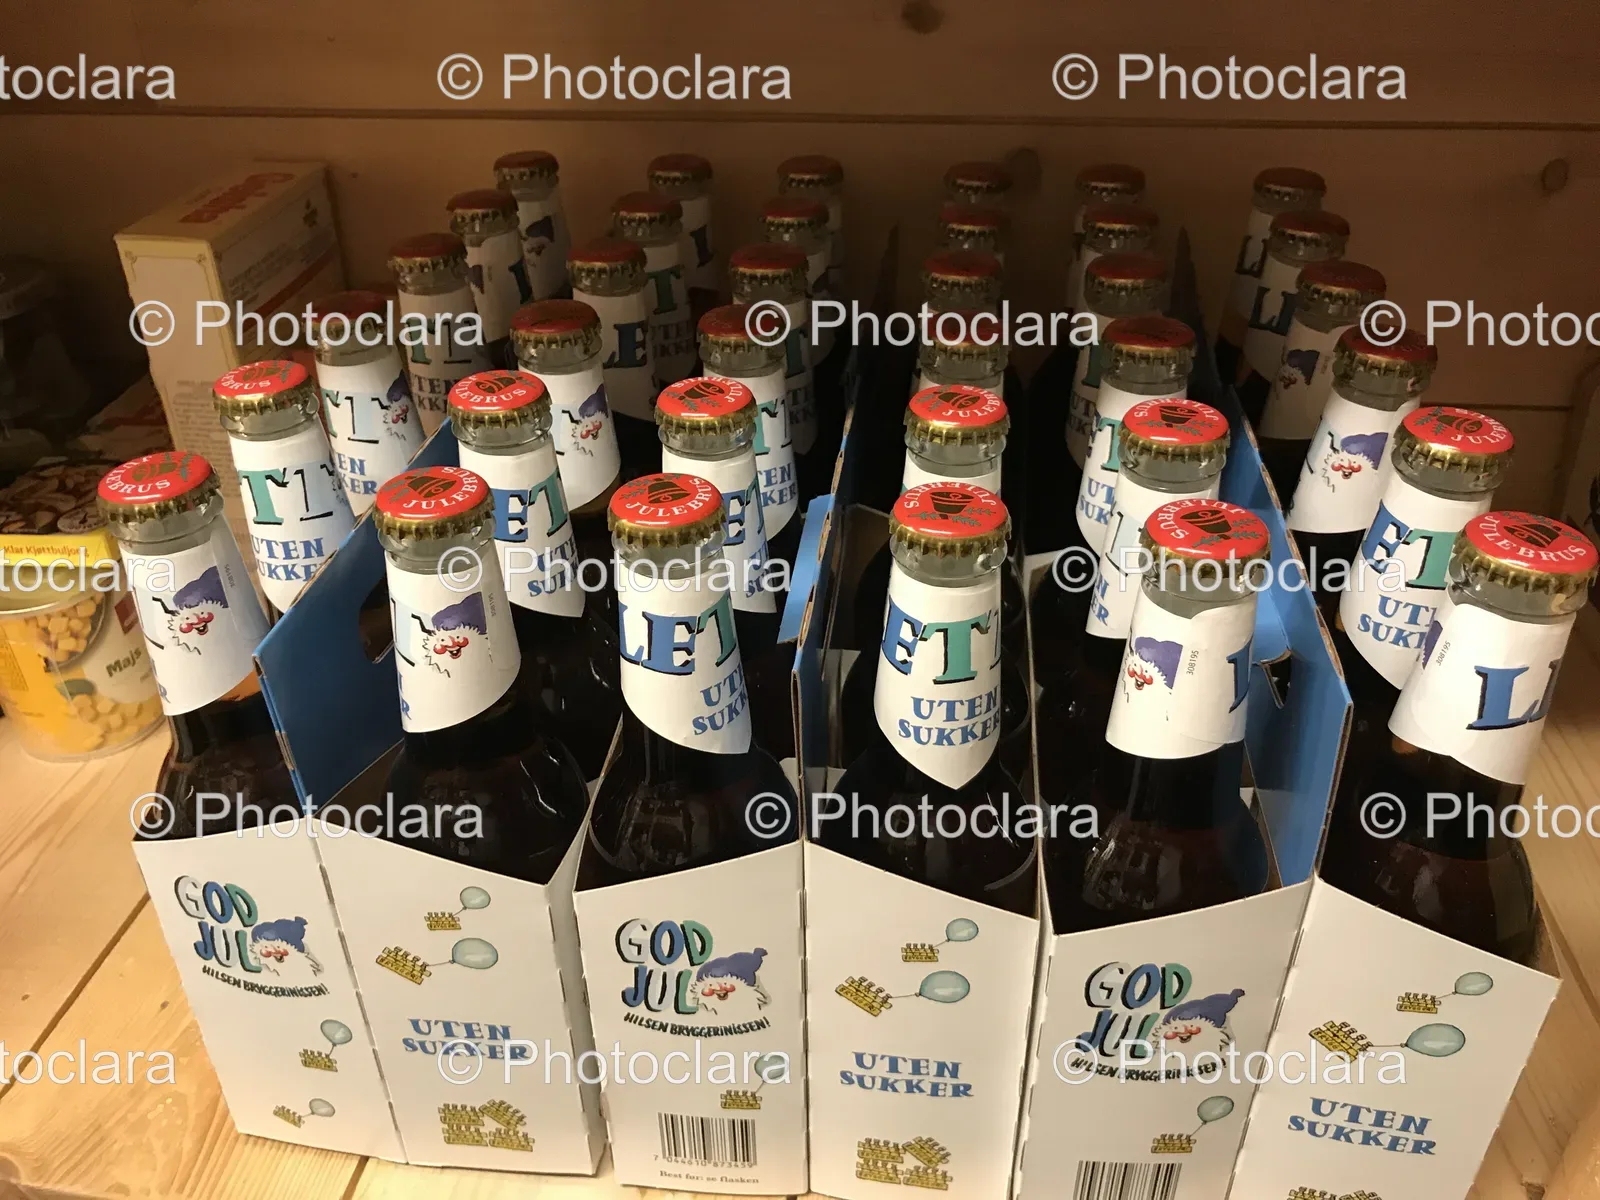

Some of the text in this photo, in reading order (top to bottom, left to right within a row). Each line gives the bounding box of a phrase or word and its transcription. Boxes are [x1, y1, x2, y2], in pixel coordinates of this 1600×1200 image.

[455, 375, 527, 404] JULEBRUS
[403, 466, 479, 510] JULEBRUS
[626, 477, 713, 518] JULEBRUS
[903, 481, 997, 510] JULEBRUS
[1157, 499, 1246, 540] JULEBRUS
[1478, 514, 1587, 563] JULEBRUS
[106, 647, 142, 678] Majs
[1186, 649, 1200, 676] 308195
[1435, 640, 1451, 667] 308195
[174, 875, 259, 927] GOD
[193, 920, 263, 974] JUL
[615, 917, 714, 967] GOD
[201, 965, 242, 990] HILSEN
[621, 964, 701, 1015] JUL
[1084, 961, 1194, 1010] GOD
[406, 1017, 513, 1041] UTEN
[623, 1011, 670, 1034] HILSEN
[1075, 1007, 1161, 1060] JUL
[401, 1036, 530, 1062] SUKKER
[851, 1050, 963, 1079] UTEN
[839, 1070, 975, 1099] SUKKER
[1308, 1096, 1433, 1137] UTEN
[1287, 1115, 1437, 1156] SUKKER
[659, 1170, 682, 1179] Best
[720, 1176, 760, 1184] flasken
